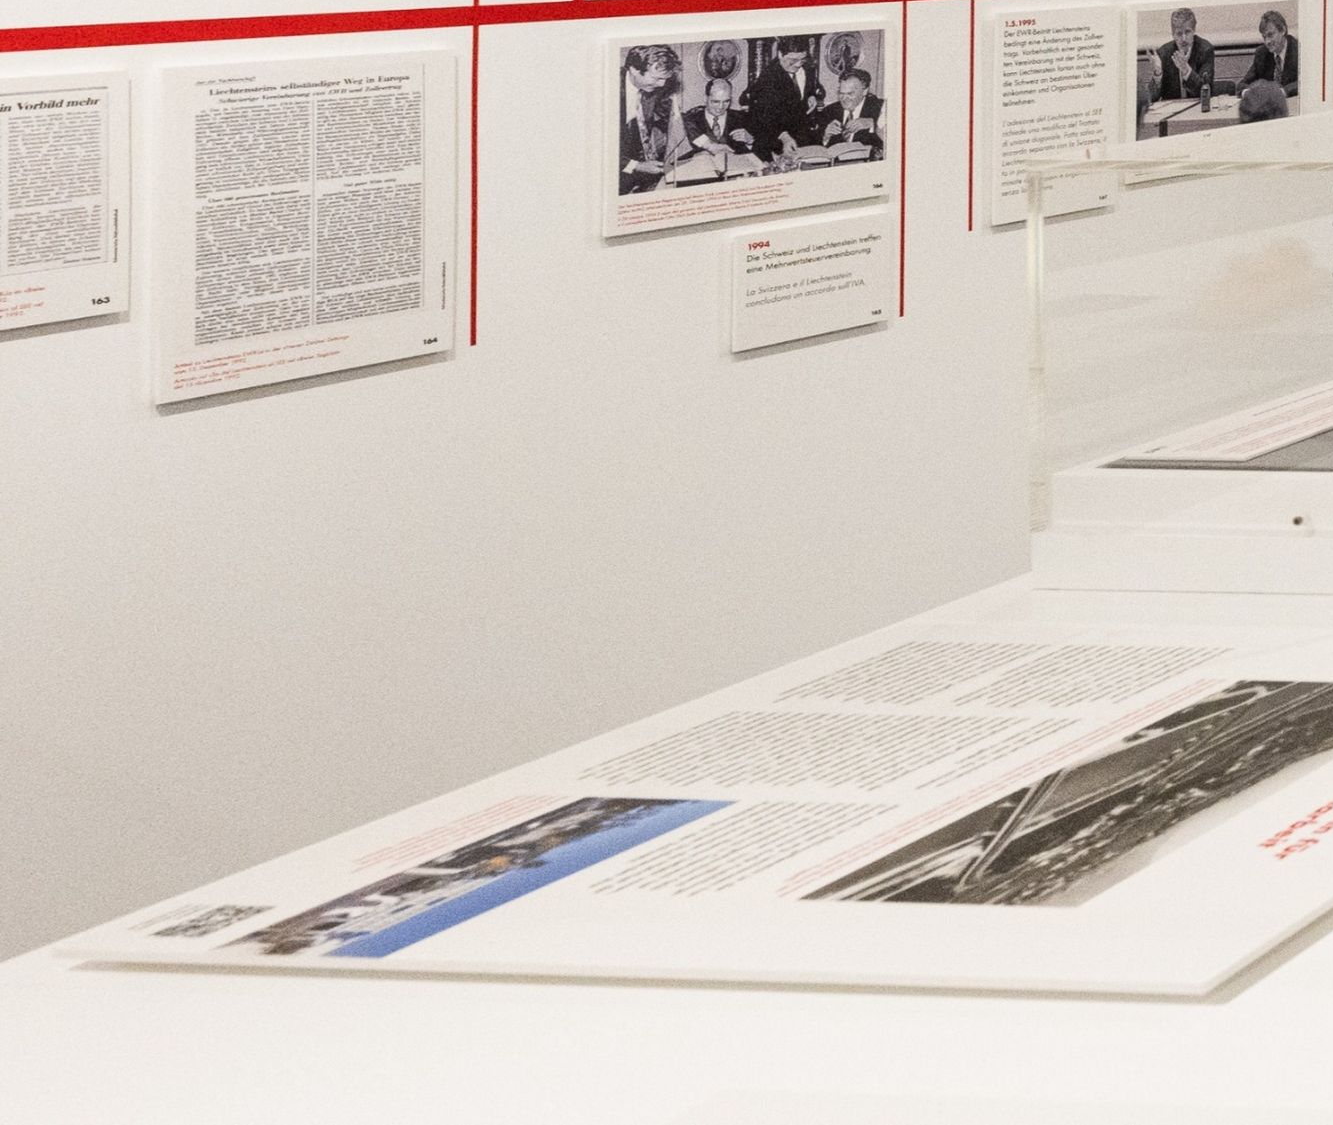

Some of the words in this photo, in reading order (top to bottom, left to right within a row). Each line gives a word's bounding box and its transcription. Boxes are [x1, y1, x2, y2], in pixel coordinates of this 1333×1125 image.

[1005, 19, 1036, 27] 1.5.1995
[17, 99, 64, 110] Vorbild
[66, 97, 100, 107] mehr
[746, 255, 760, 263] Die
[763, 249, 795, 260] Schweiz
[796, 245, 810, 254] und
[812, 238, 858, 252] Liechtenstein
[748, 240, 770, 251] 1994
[746, 266, 763, 274] eine
[758, 283, 791, 294] Svizzera
[806, 272, 852, 285] Liechtenstein
